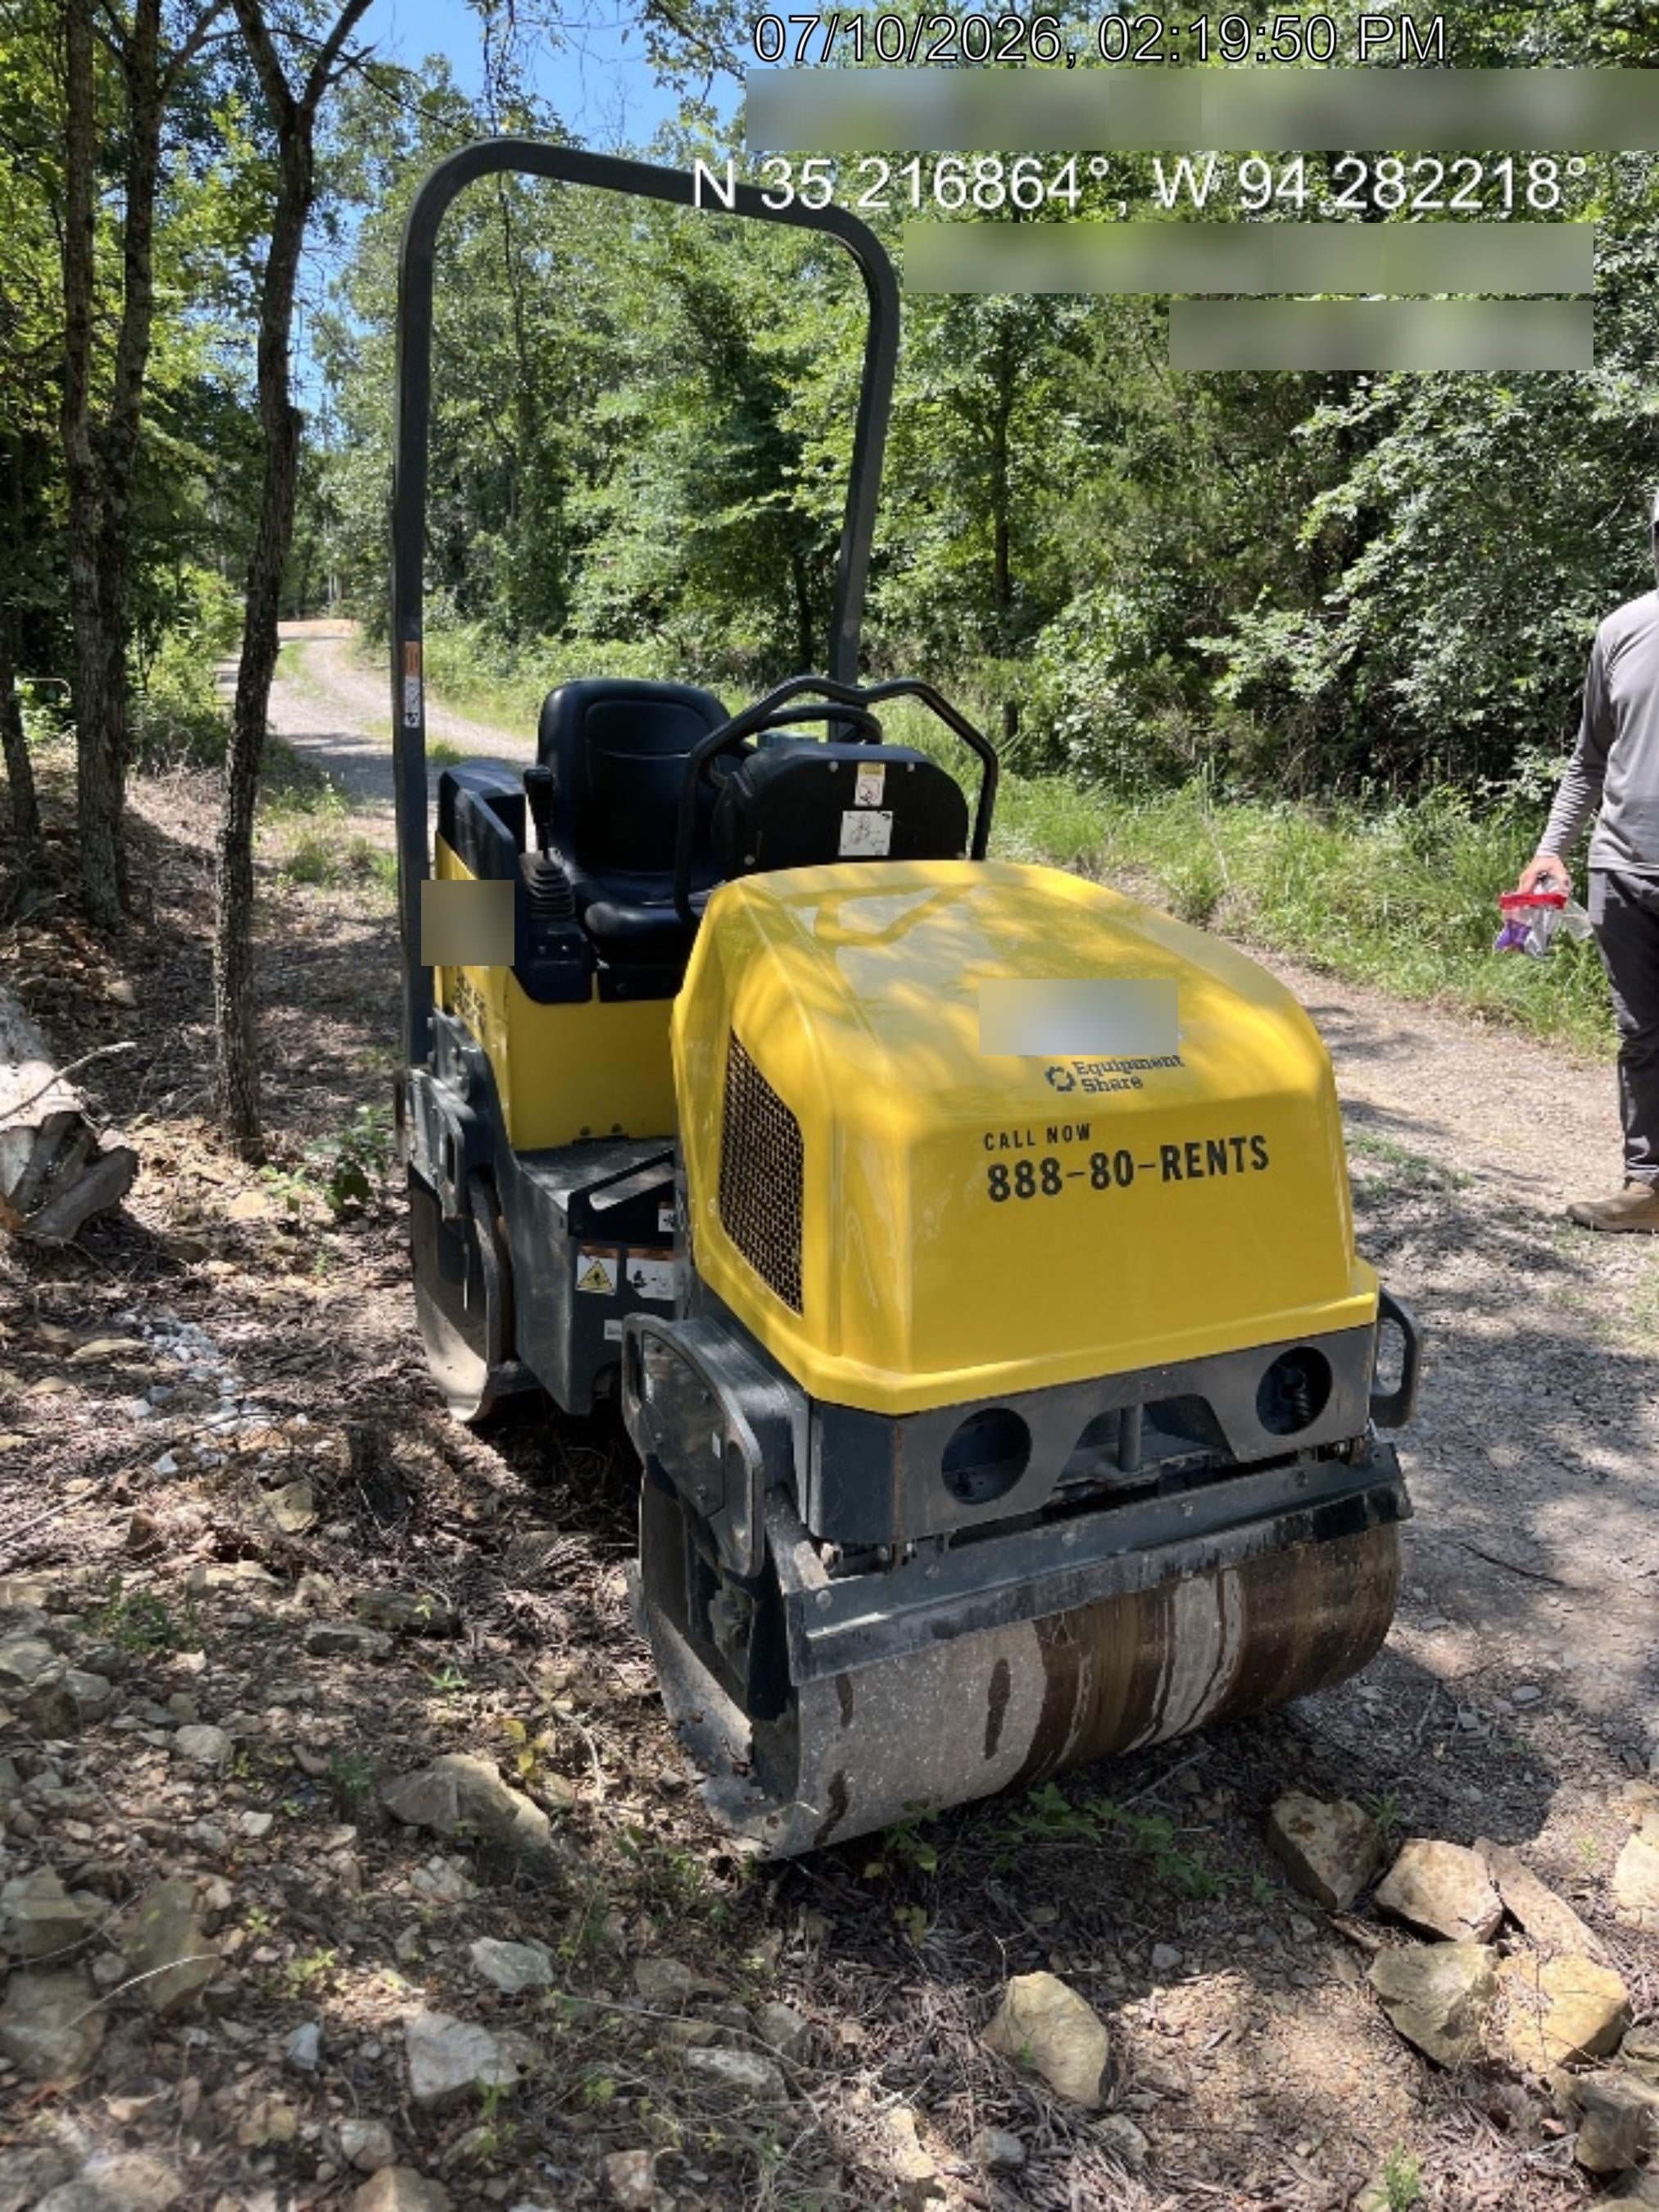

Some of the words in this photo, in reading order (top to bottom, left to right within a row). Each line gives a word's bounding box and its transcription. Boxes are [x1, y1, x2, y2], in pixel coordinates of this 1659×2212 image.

[1072, 1055, 1185, 1077] Equipment
[1081, 1077, 1144, 1093] Share
[984, 1130, 1036, 1151] CALL
[1046, 1123, 1091, 1145] NOW
[987, 1135, 1269, 1203] 888-80-RENTS
